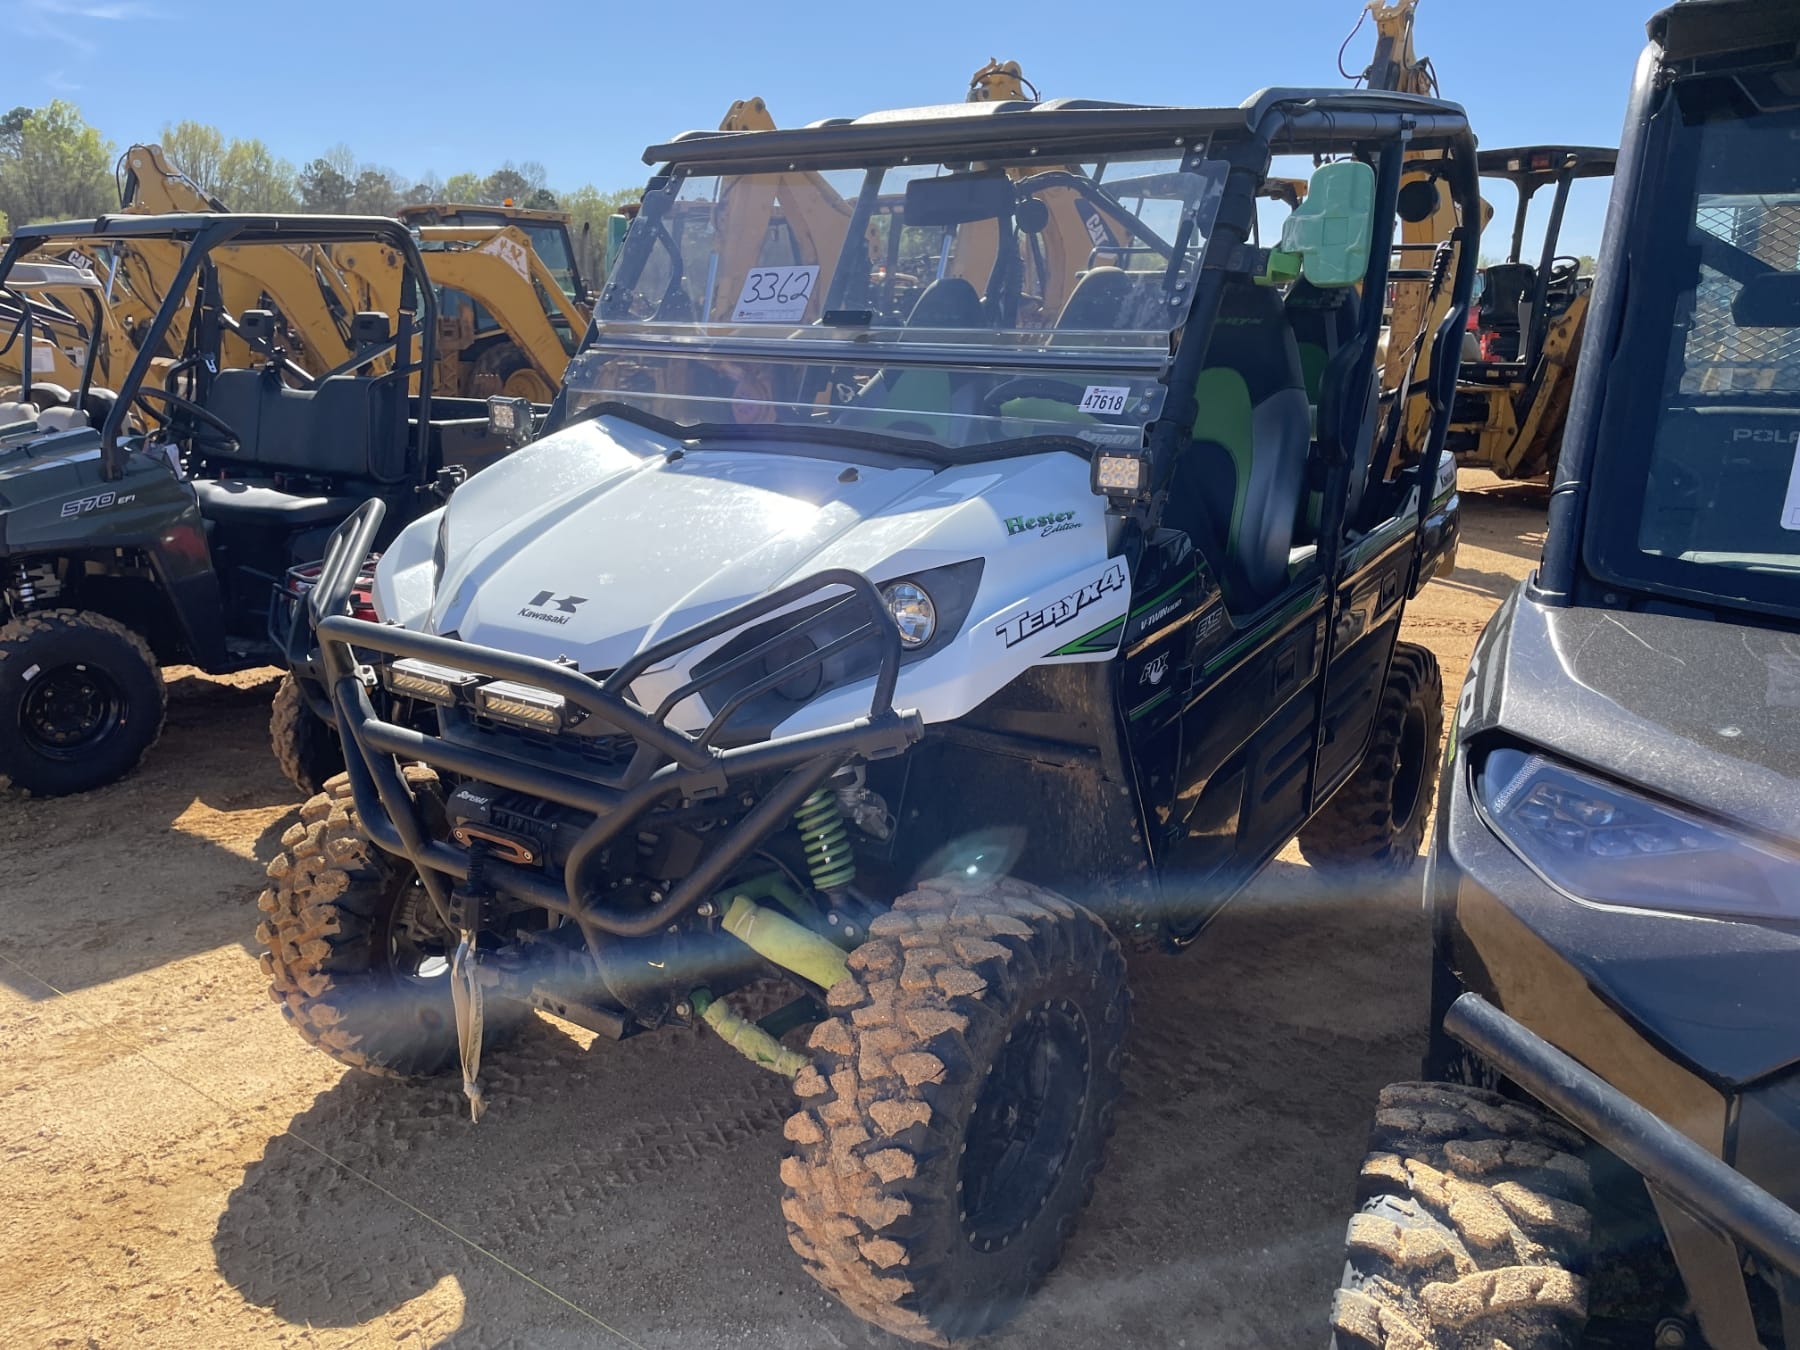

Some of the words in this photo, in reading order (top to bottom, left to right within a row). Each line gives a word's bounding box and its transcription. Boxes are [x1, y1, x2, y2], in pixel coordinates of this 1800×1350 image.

[1086, 213, 1109, 246] CAT
[68, 250, 93, 269] CAT
[744, 272, 809, 304] 3362
[1084, 395, 1124, 411] 47618
[61, 491, 116, 517] 570
[1003, 510, 1076, 537] Hester
[1040, 522, 1083, 538] Edition
[517, 607, 571, 625] Kawasaki
[1140, 605, 1168, 631] V-TWIN
[1138, 650, 1171, 685] FOX
